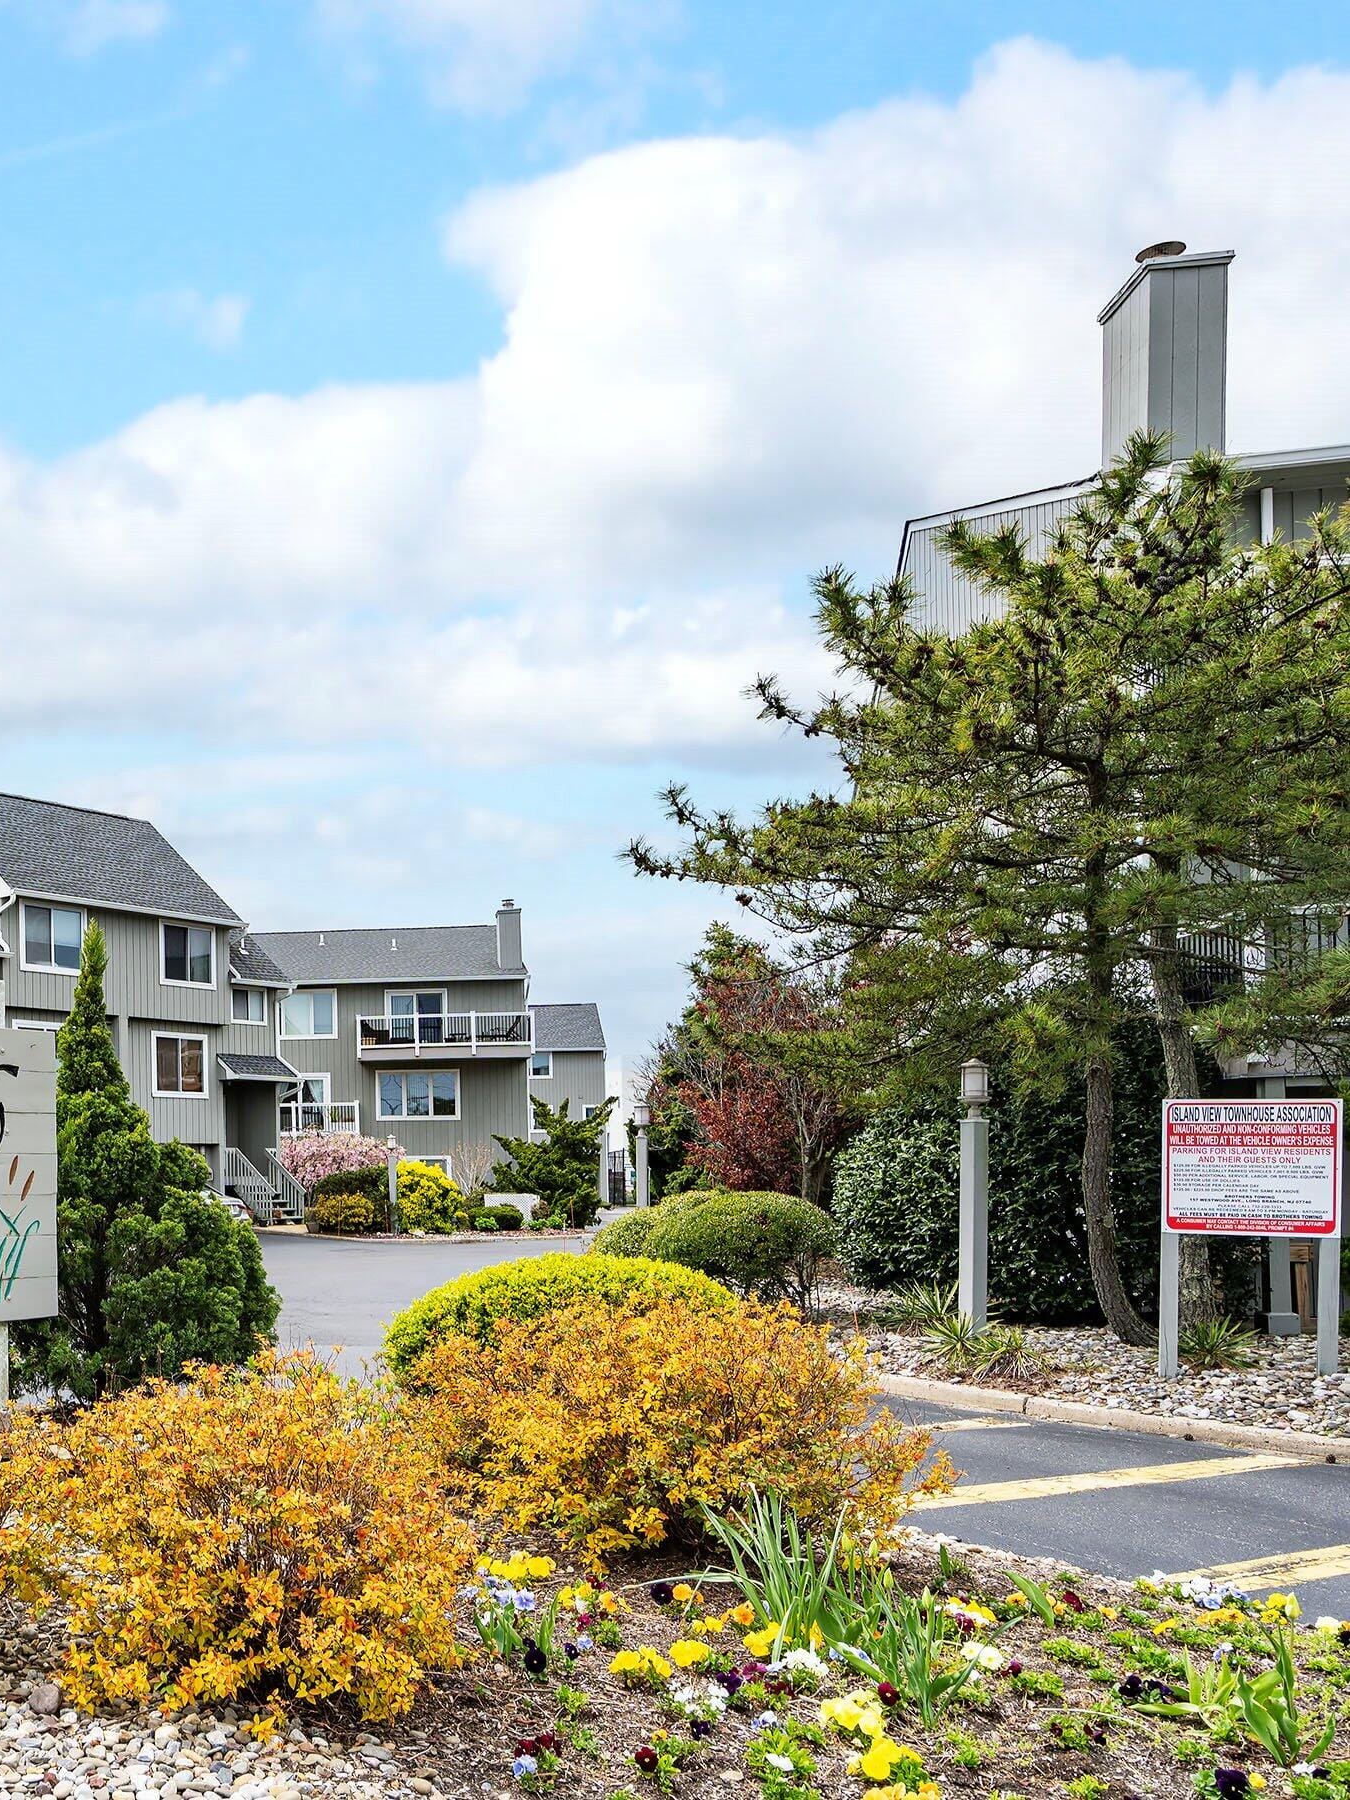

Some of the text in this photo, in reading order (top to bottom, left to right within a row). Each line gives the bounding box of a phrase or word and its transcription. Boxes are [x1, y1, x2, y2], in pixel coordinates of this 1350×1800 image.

[1172, 1106, 1332, 1122] ISLAND VIEW TOWNHOUSE ASSOCIATION
[1173, 1125, 1330, 1134] UNAUTHORIZED AND NON-CONFORMING VEHICLES
[1170, 1136, 1334, 1146] WILL BE TOWED AT THE VEHICLE OWNER'S EXPENSE
